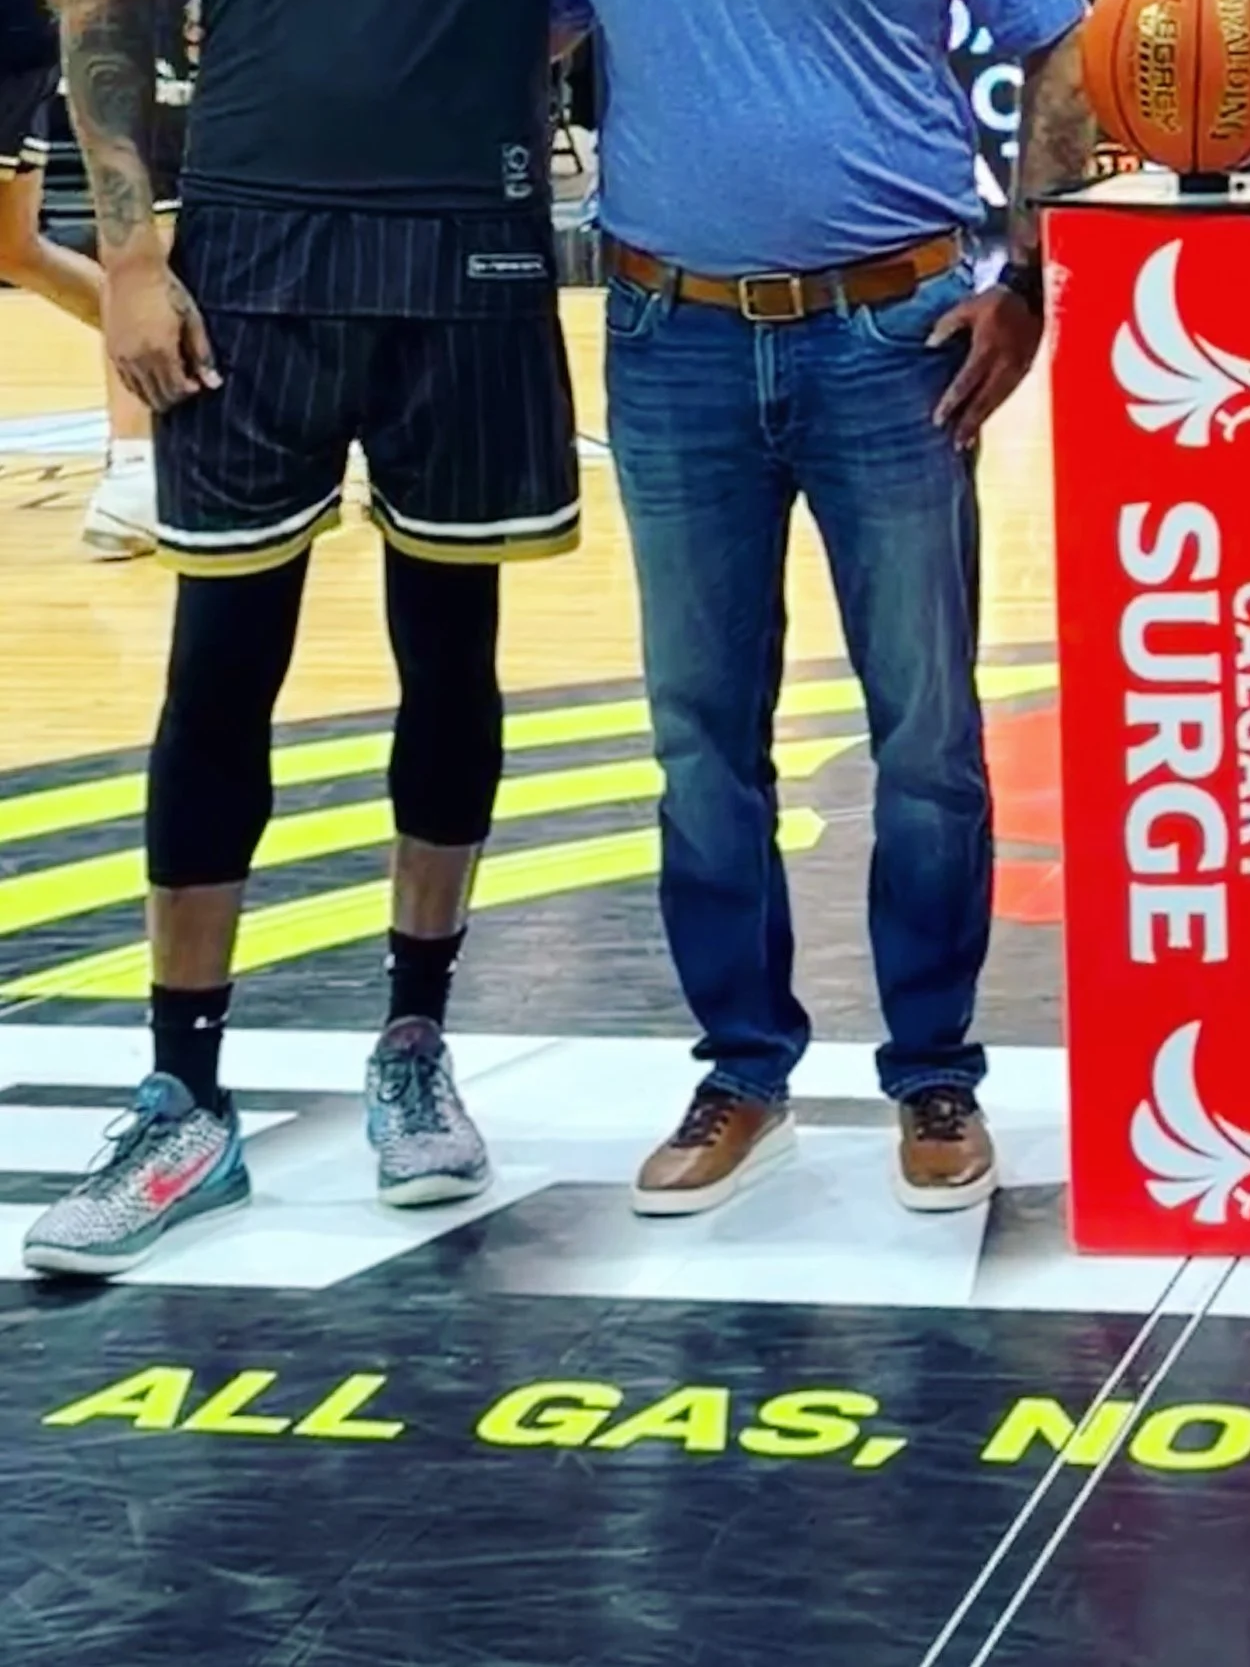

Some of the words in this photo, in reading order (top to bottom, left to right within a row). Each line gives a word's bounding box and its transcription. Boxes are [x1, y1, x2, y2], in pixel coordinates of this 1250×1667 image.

[1116, 501, 1229, 965] SURGE
[41, 1366, 405, 1439] ALL
[476, 1380, 908, 1466] GAS,
